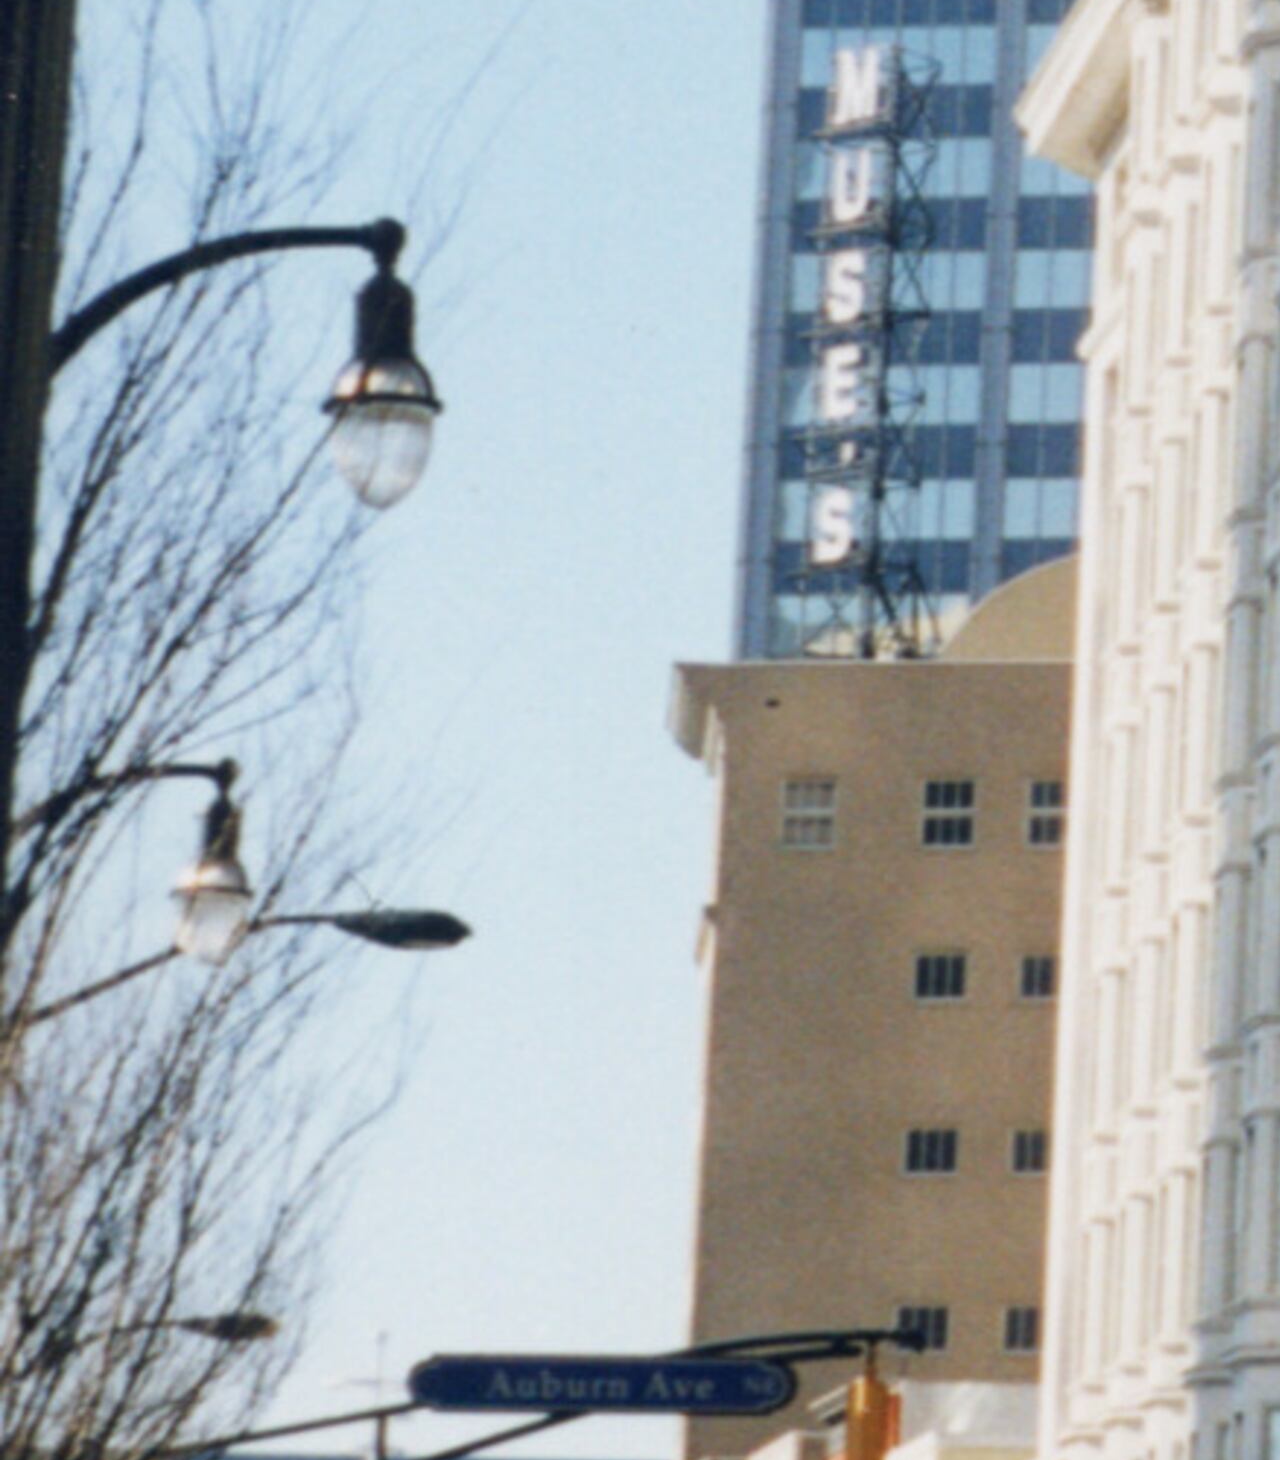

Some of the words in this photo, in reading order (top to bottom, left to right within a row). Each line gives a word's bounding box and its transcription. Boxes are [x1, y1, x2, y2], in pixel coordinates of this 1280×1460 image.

[810, 47, 880, 566] MUSE'S
[486, 1368, 628, 1399] Auburn
[645, 1370, 716, 1399] Ave
